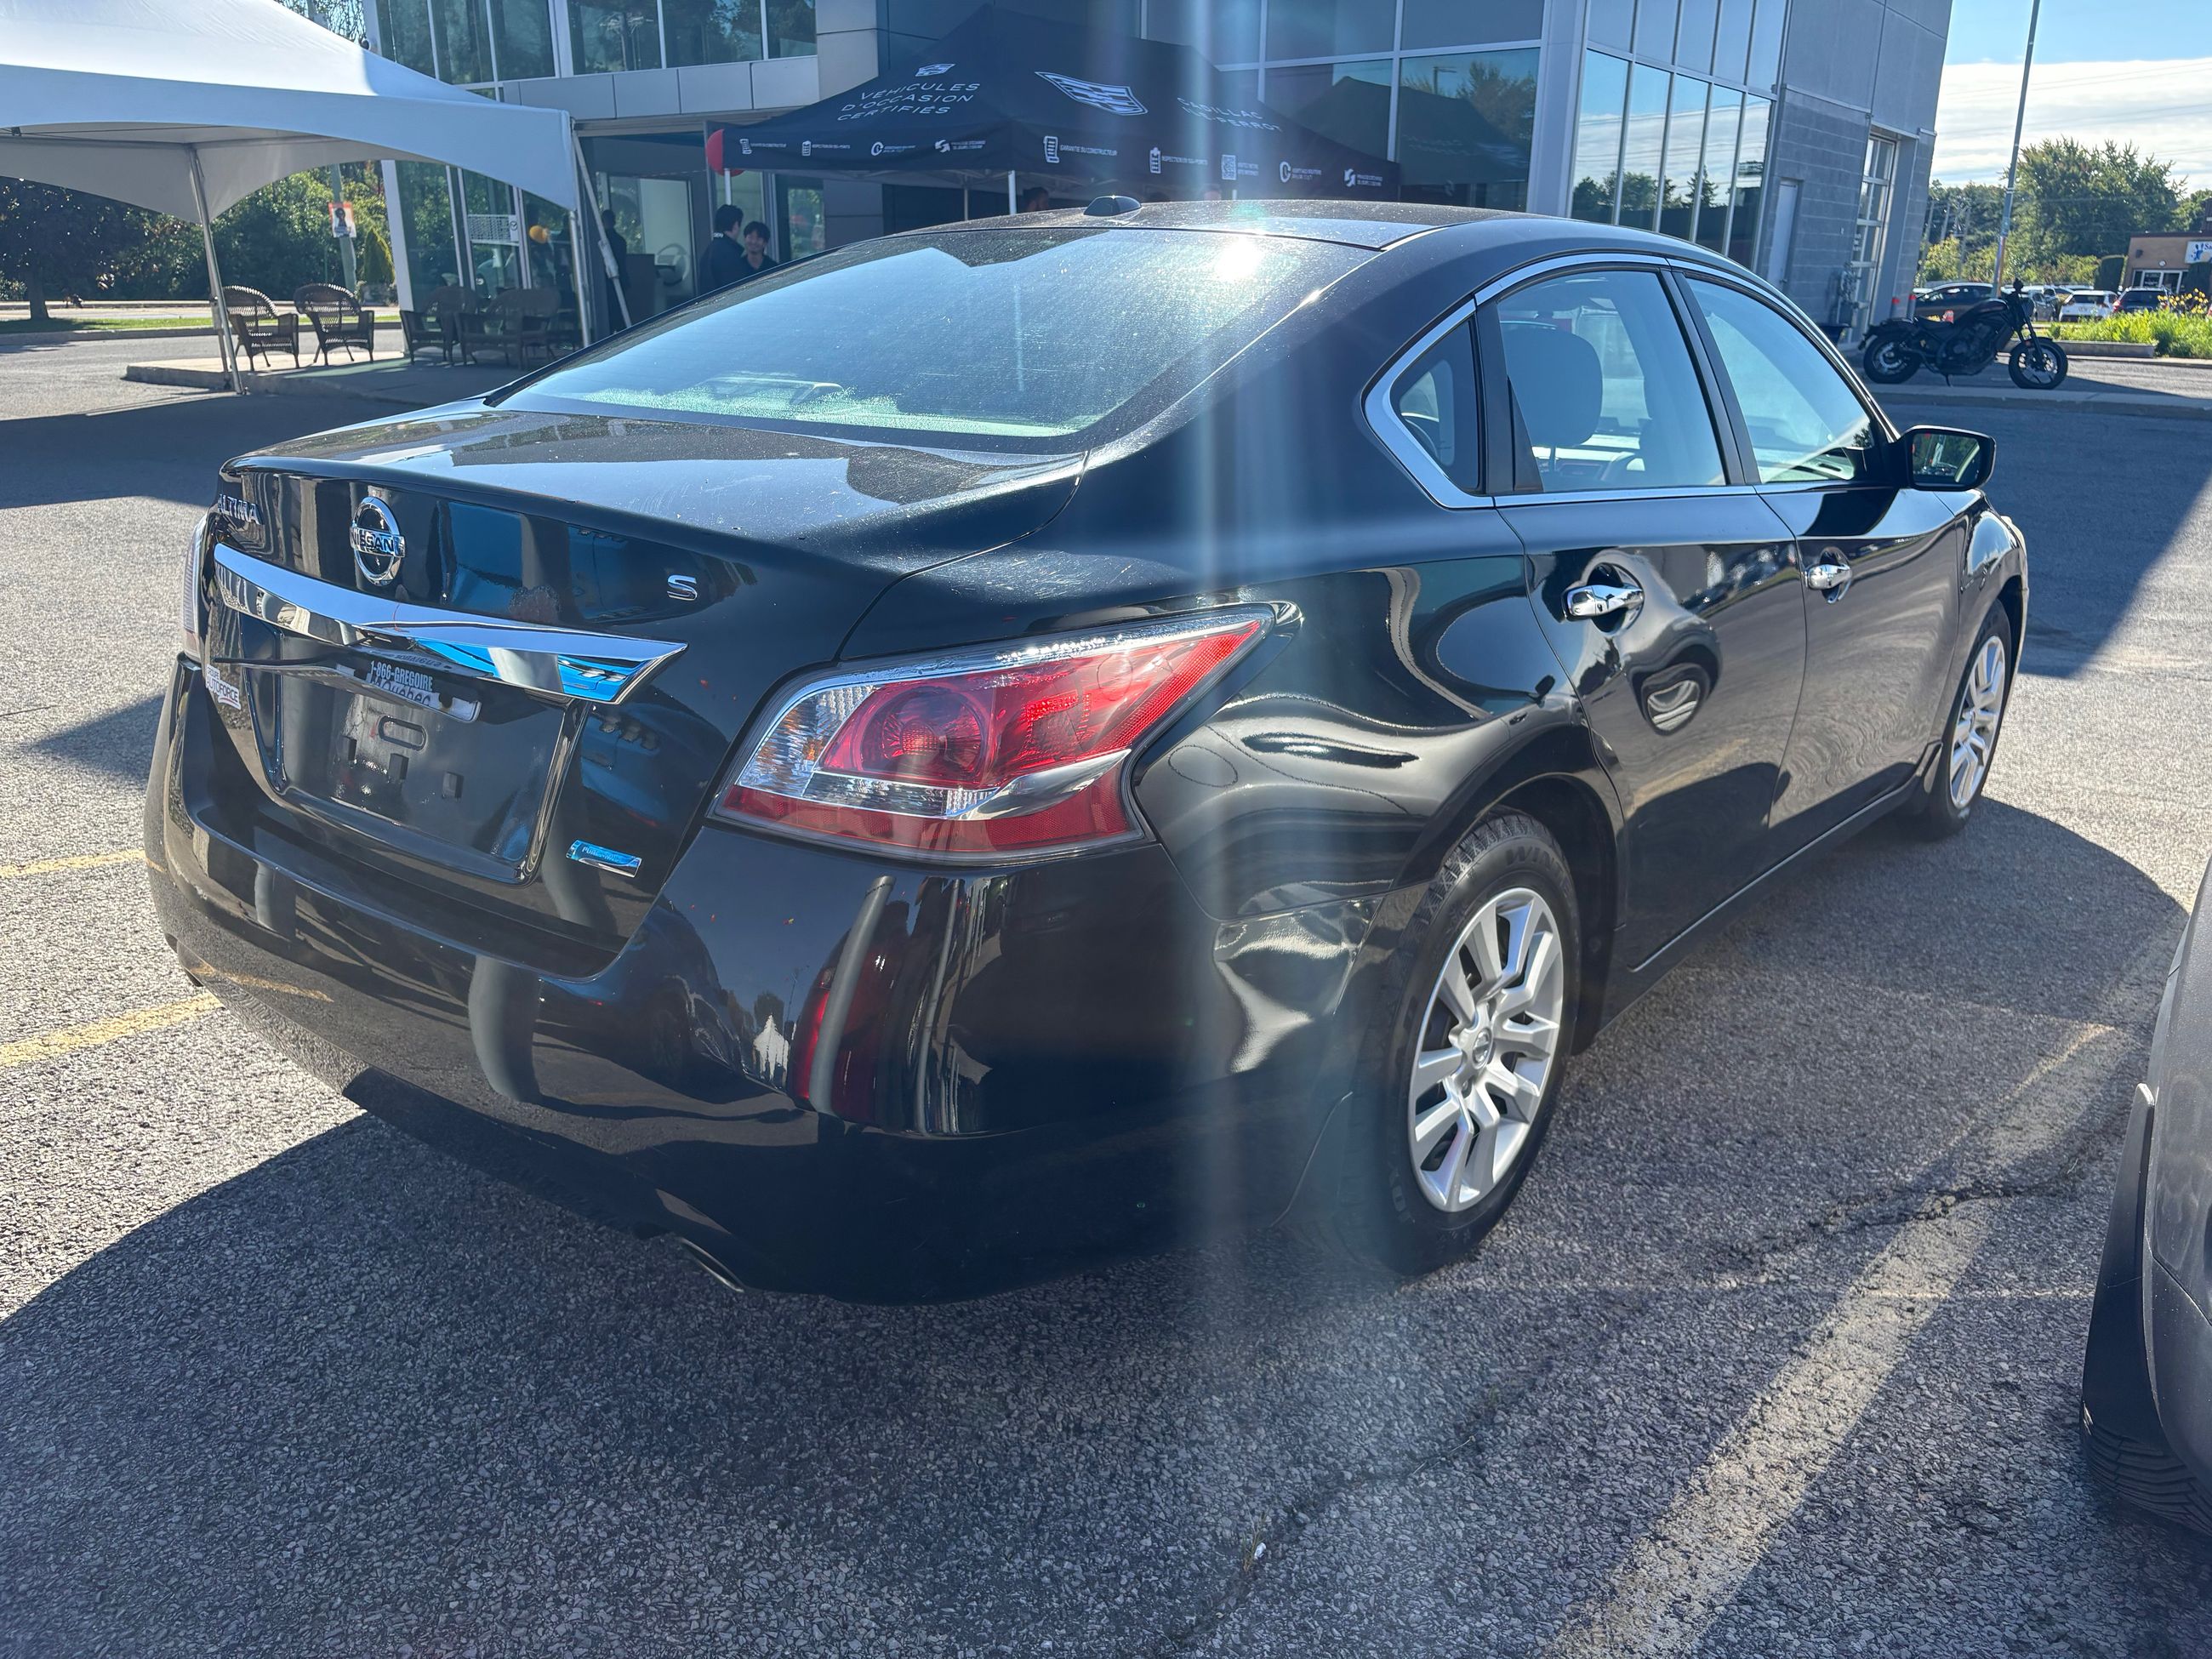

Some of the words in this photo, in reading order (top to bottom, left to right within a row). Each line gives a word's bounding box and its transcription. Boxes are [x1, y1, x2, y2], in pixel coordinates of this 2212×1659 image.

[837, 105, 950, 121] CERTIFIÉS
[841, 94, 973, 111] D'OCCASION
[1177, 97, 1263, 119] CADILLAC
[218, 494, 260, 525] ALTIMA
[350, 528, 394, 552] NISSAN
[667, 575, 698, 601] S
[371, 660, 433, 691] 1-866-GREGOIRE
[207, 675, 238, 703] AUTOFORCE
